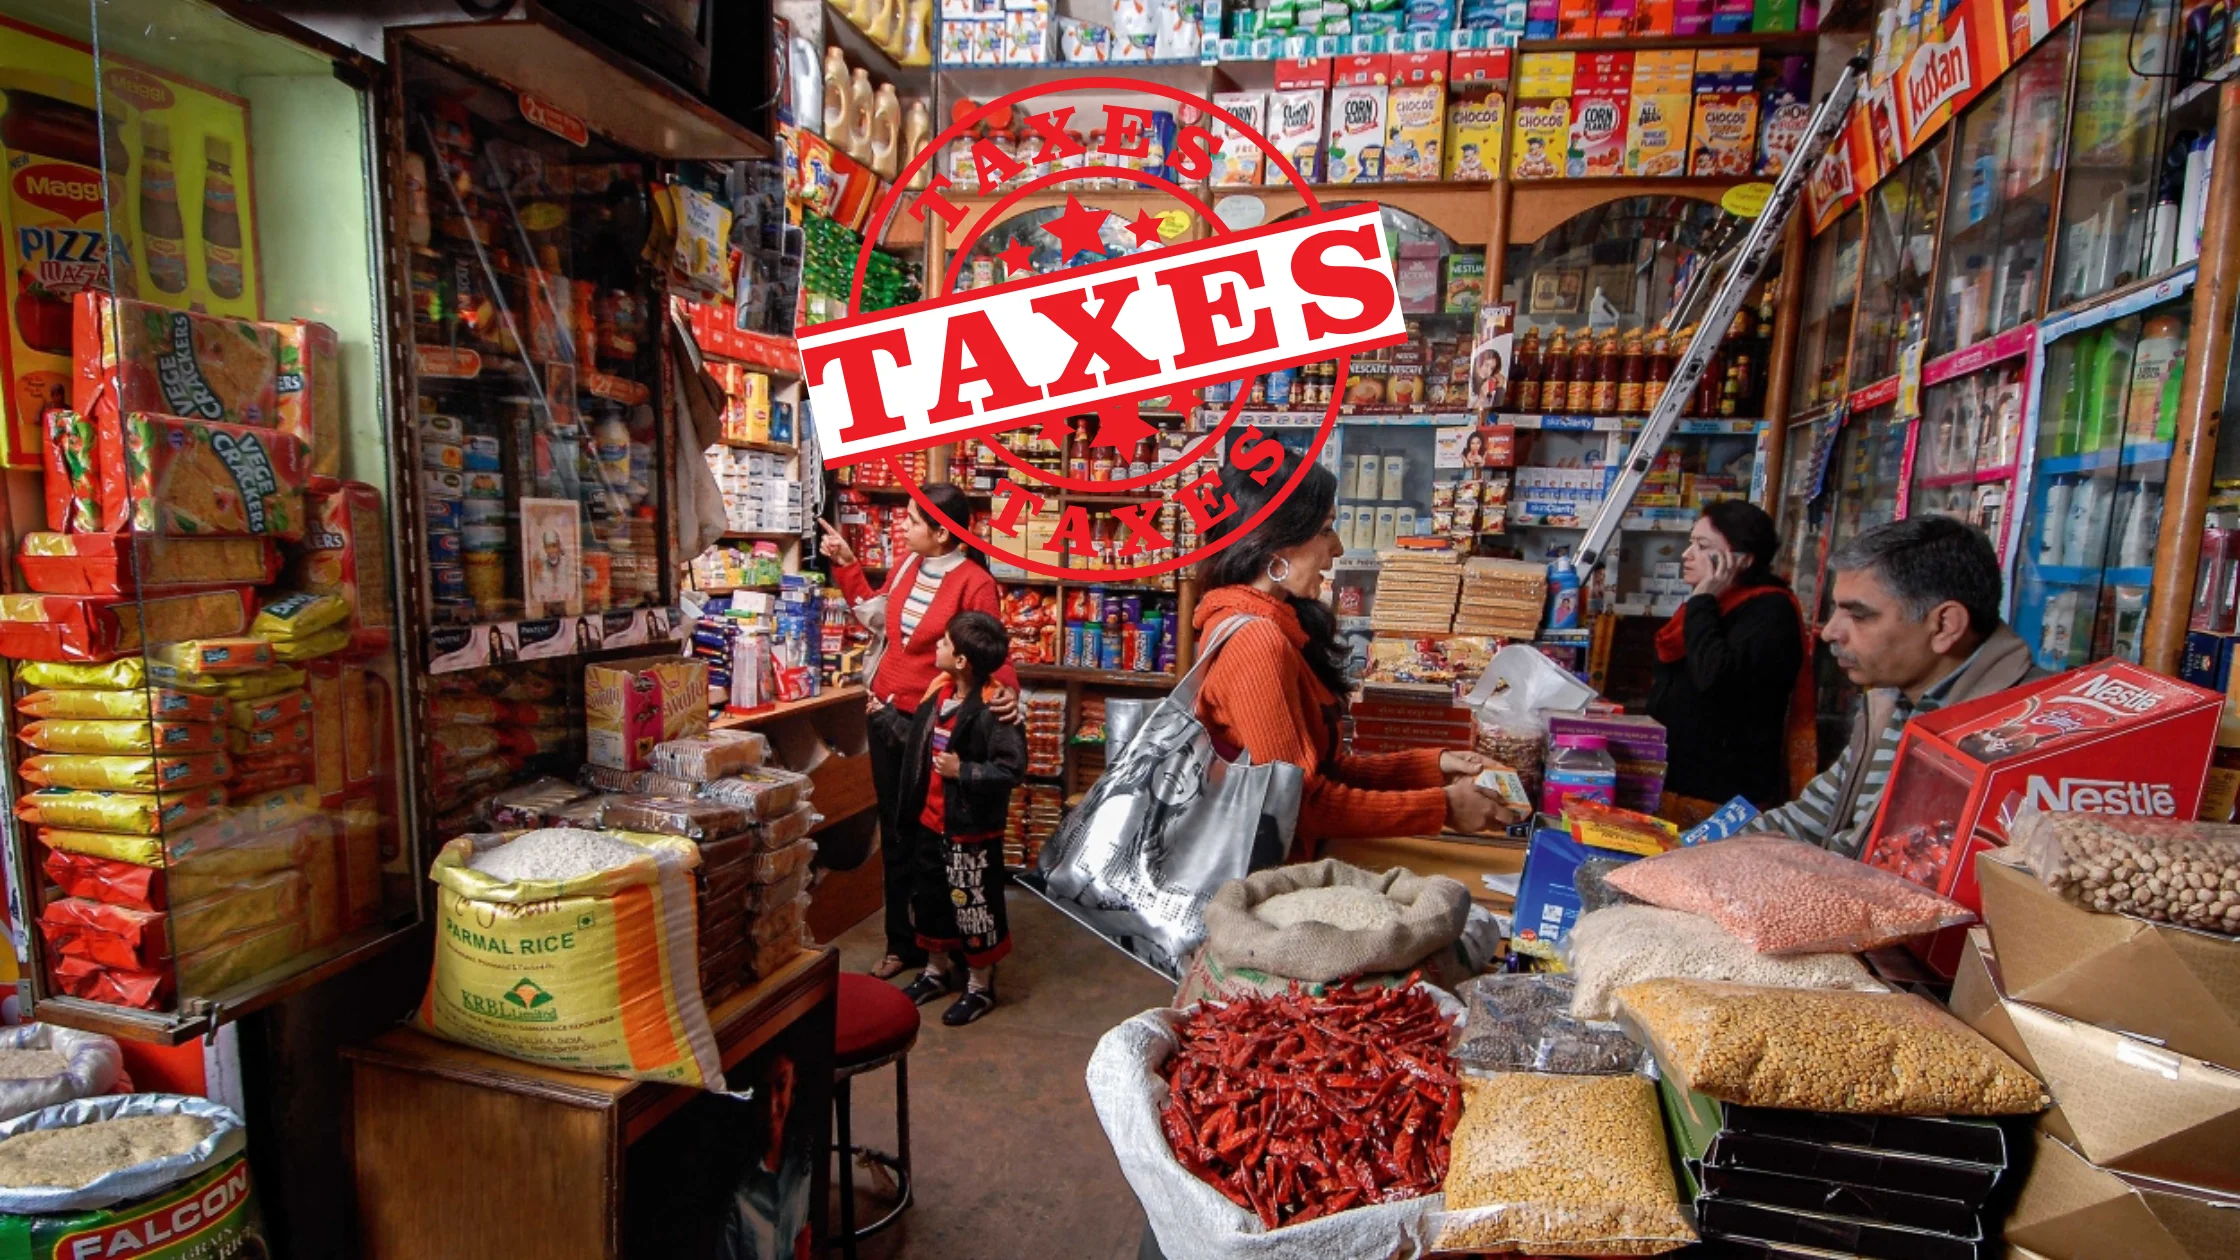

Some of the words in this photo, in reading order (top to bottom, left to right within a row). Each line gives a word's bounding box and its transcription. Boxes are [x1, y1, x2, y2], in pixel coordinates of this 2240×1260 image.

[1452, 111, 1498, 123] CHOCOS
[1518, 115, 1563, 128] CHOCOS
[1585, 108, 1613, 122] CORN
[1705, 111, 1747, 124] CHOCOS
[20, 227, 132, 265] PIZZA
[171, 313, 223, 420] CRACKERS
[240, 432, 277, 495] VEGE
[212, 433, 265, 534] CRACKERS
[446, 917, 513, 955] PARMAL
[520, 932, 576, 955] RICE
[461, 989, 511, 1020] KRBL
[71, 1168, 247, 1260] FALCON
